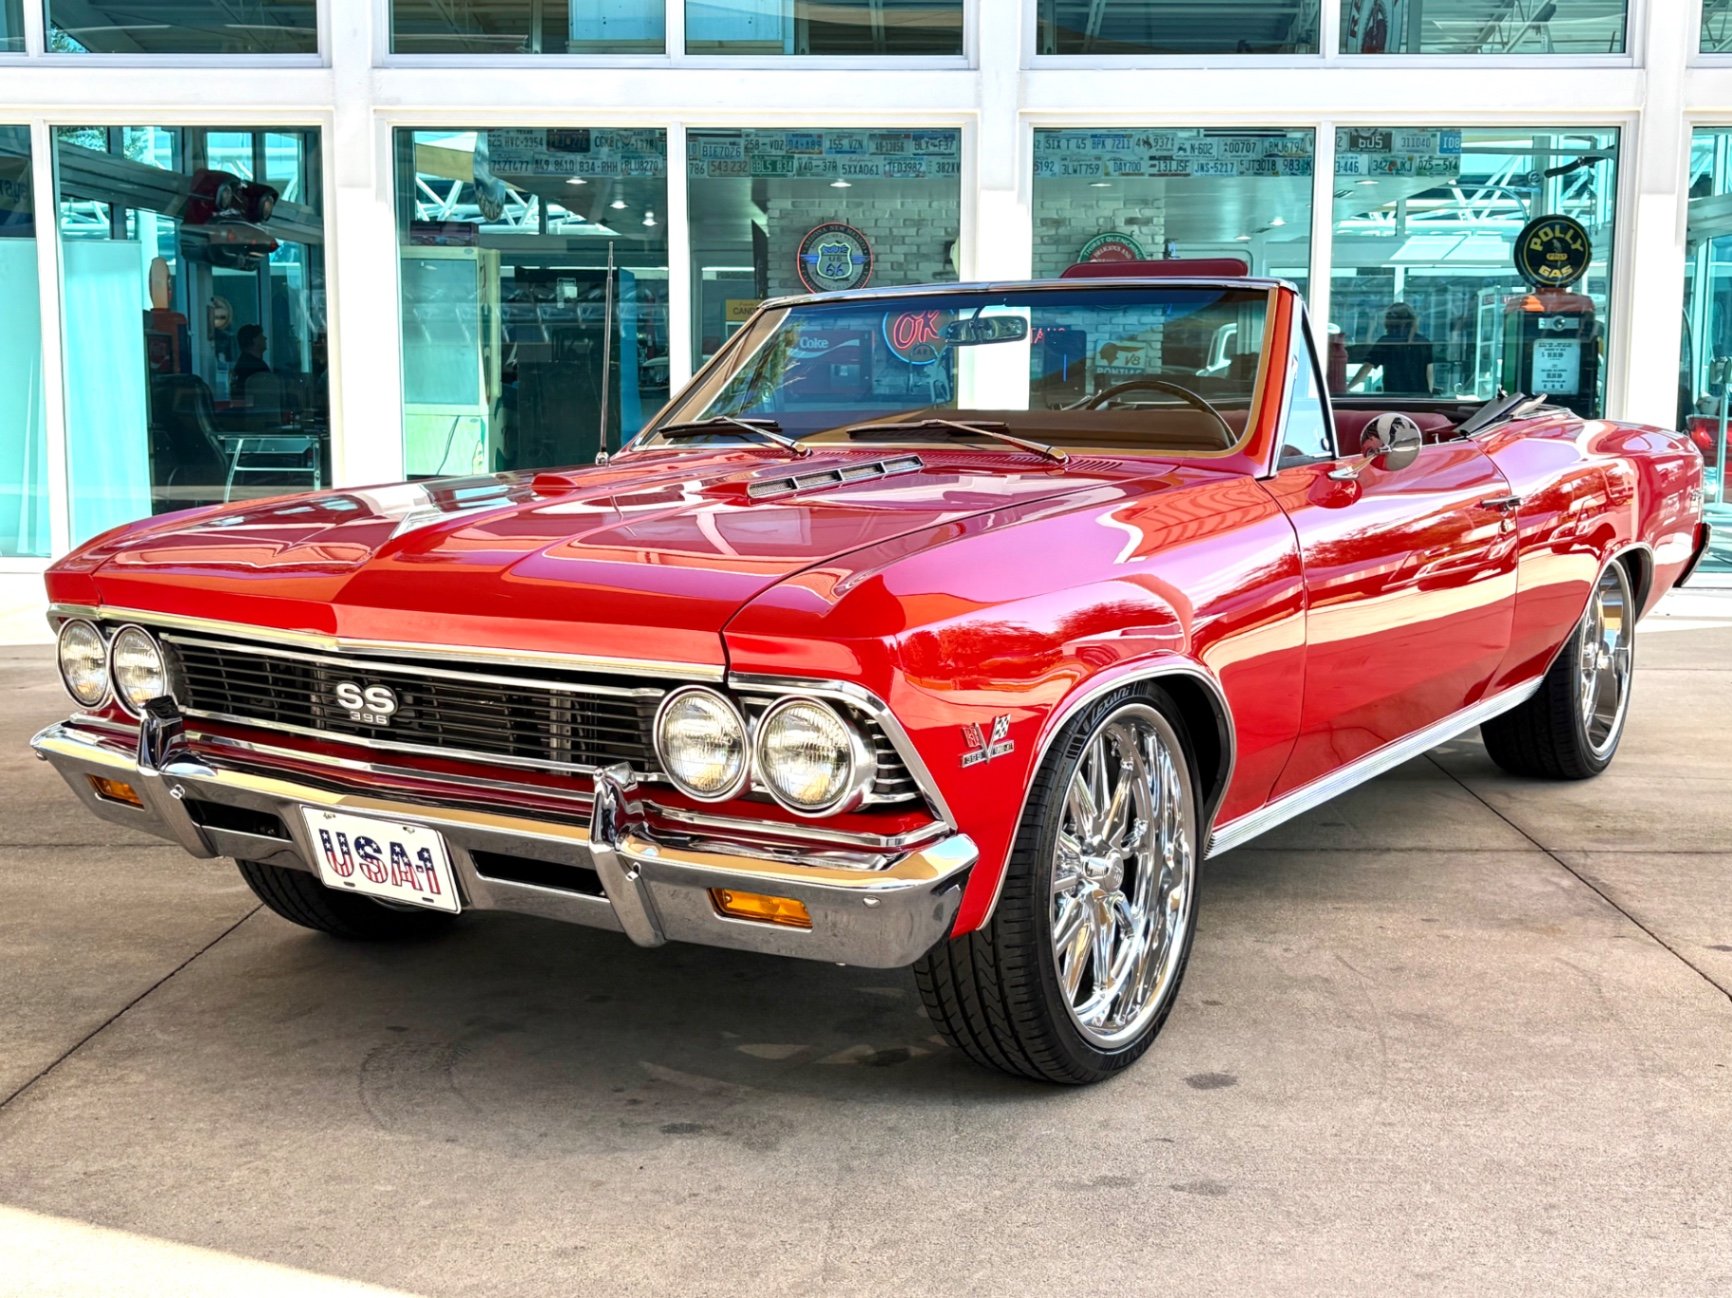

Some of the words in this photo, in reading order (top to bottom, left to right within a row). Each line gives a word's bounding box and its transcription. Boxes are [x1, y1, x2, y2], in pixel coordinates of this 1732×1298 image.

[1530, 224, 1584, 251] POLLY
[826, 263, 845, 277] 66
[1538, 265, 1573, 278] GAS
[733, 306, 758, 315] CAND
[893, 310, 941, 350] OK
[800, 336, 830, 349] Coke
[1124, 354, 1141, 366] V8
[336, 682, 396, 714] SS
[350, 710, 388, 725] 396
